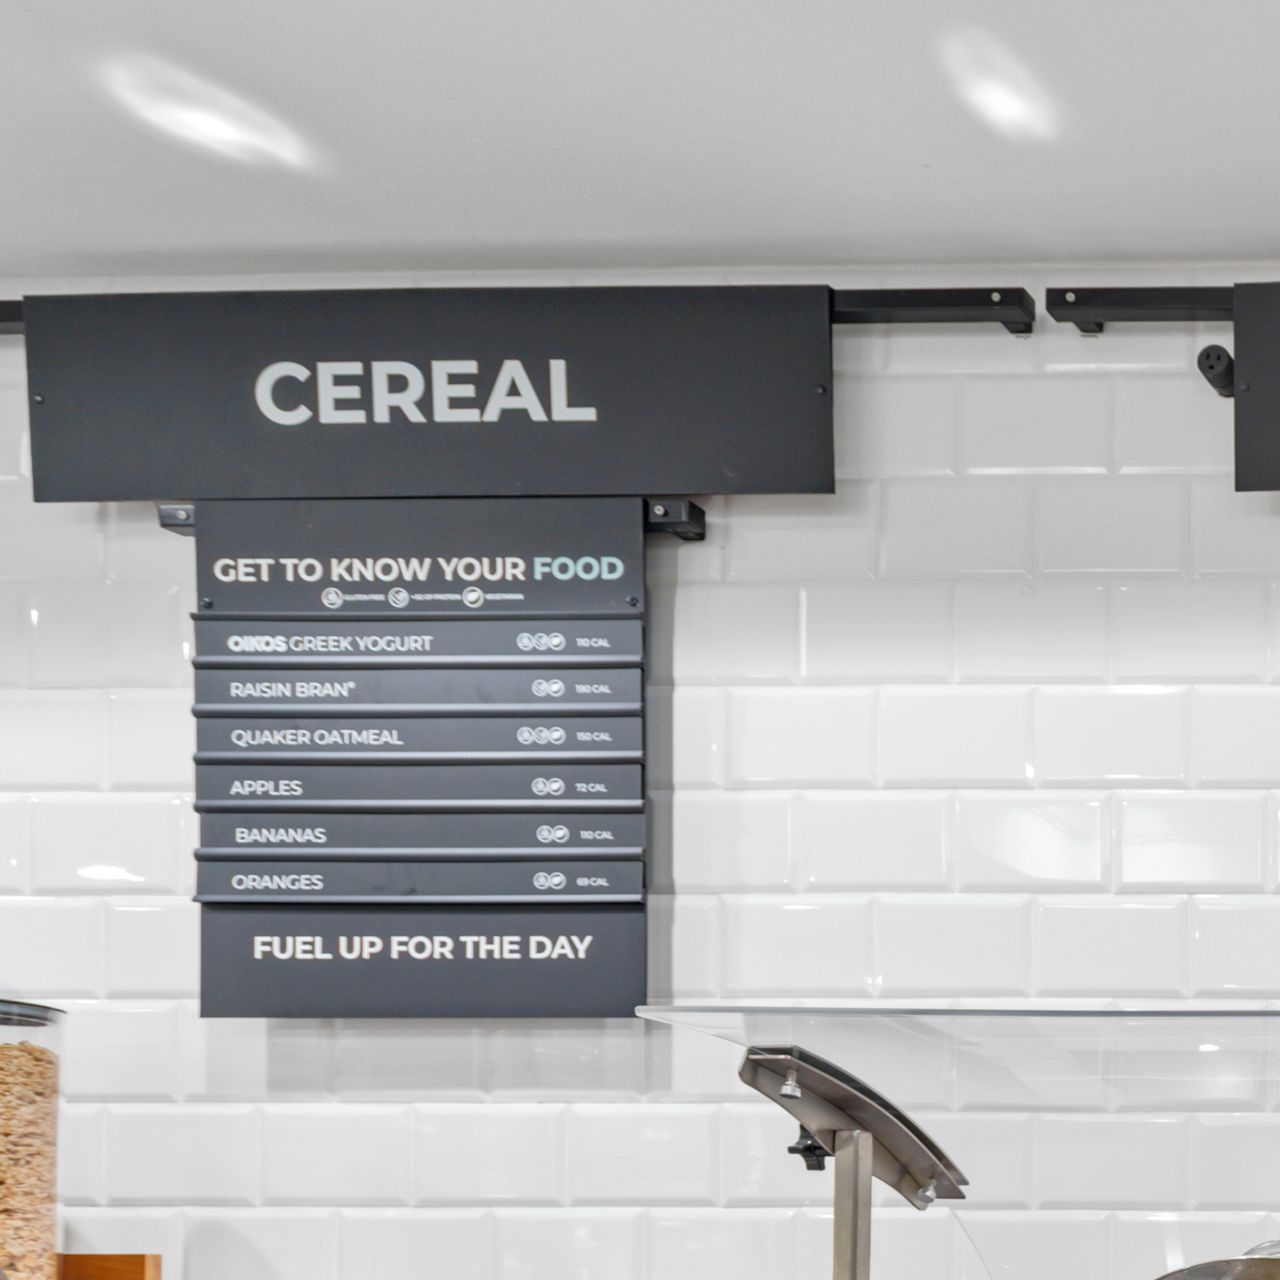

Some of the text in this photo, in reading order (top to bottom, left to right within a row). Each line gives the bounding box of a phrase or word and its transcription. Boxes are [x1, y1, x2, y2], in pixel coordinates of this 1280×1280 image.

[255, 359, 597, 425] CEREAL
[214, 557, 624, 582] GET TO KNOW YOUR FOOD
[289, 636, 353, 651] GREEK
[355, 636, 433, 651] YOGURT
[231, 682, 291, 697] RAISIN
[231, 730, 404, 747] QUAKER OATMEAL
[230, 780, 303, 795] APPLES
[236, 828, 327, 843] BANANAS
[232, 875, 323, 889] ORANGES
[254, 936, 592, 959] FUEL UP FOR THE DAY
